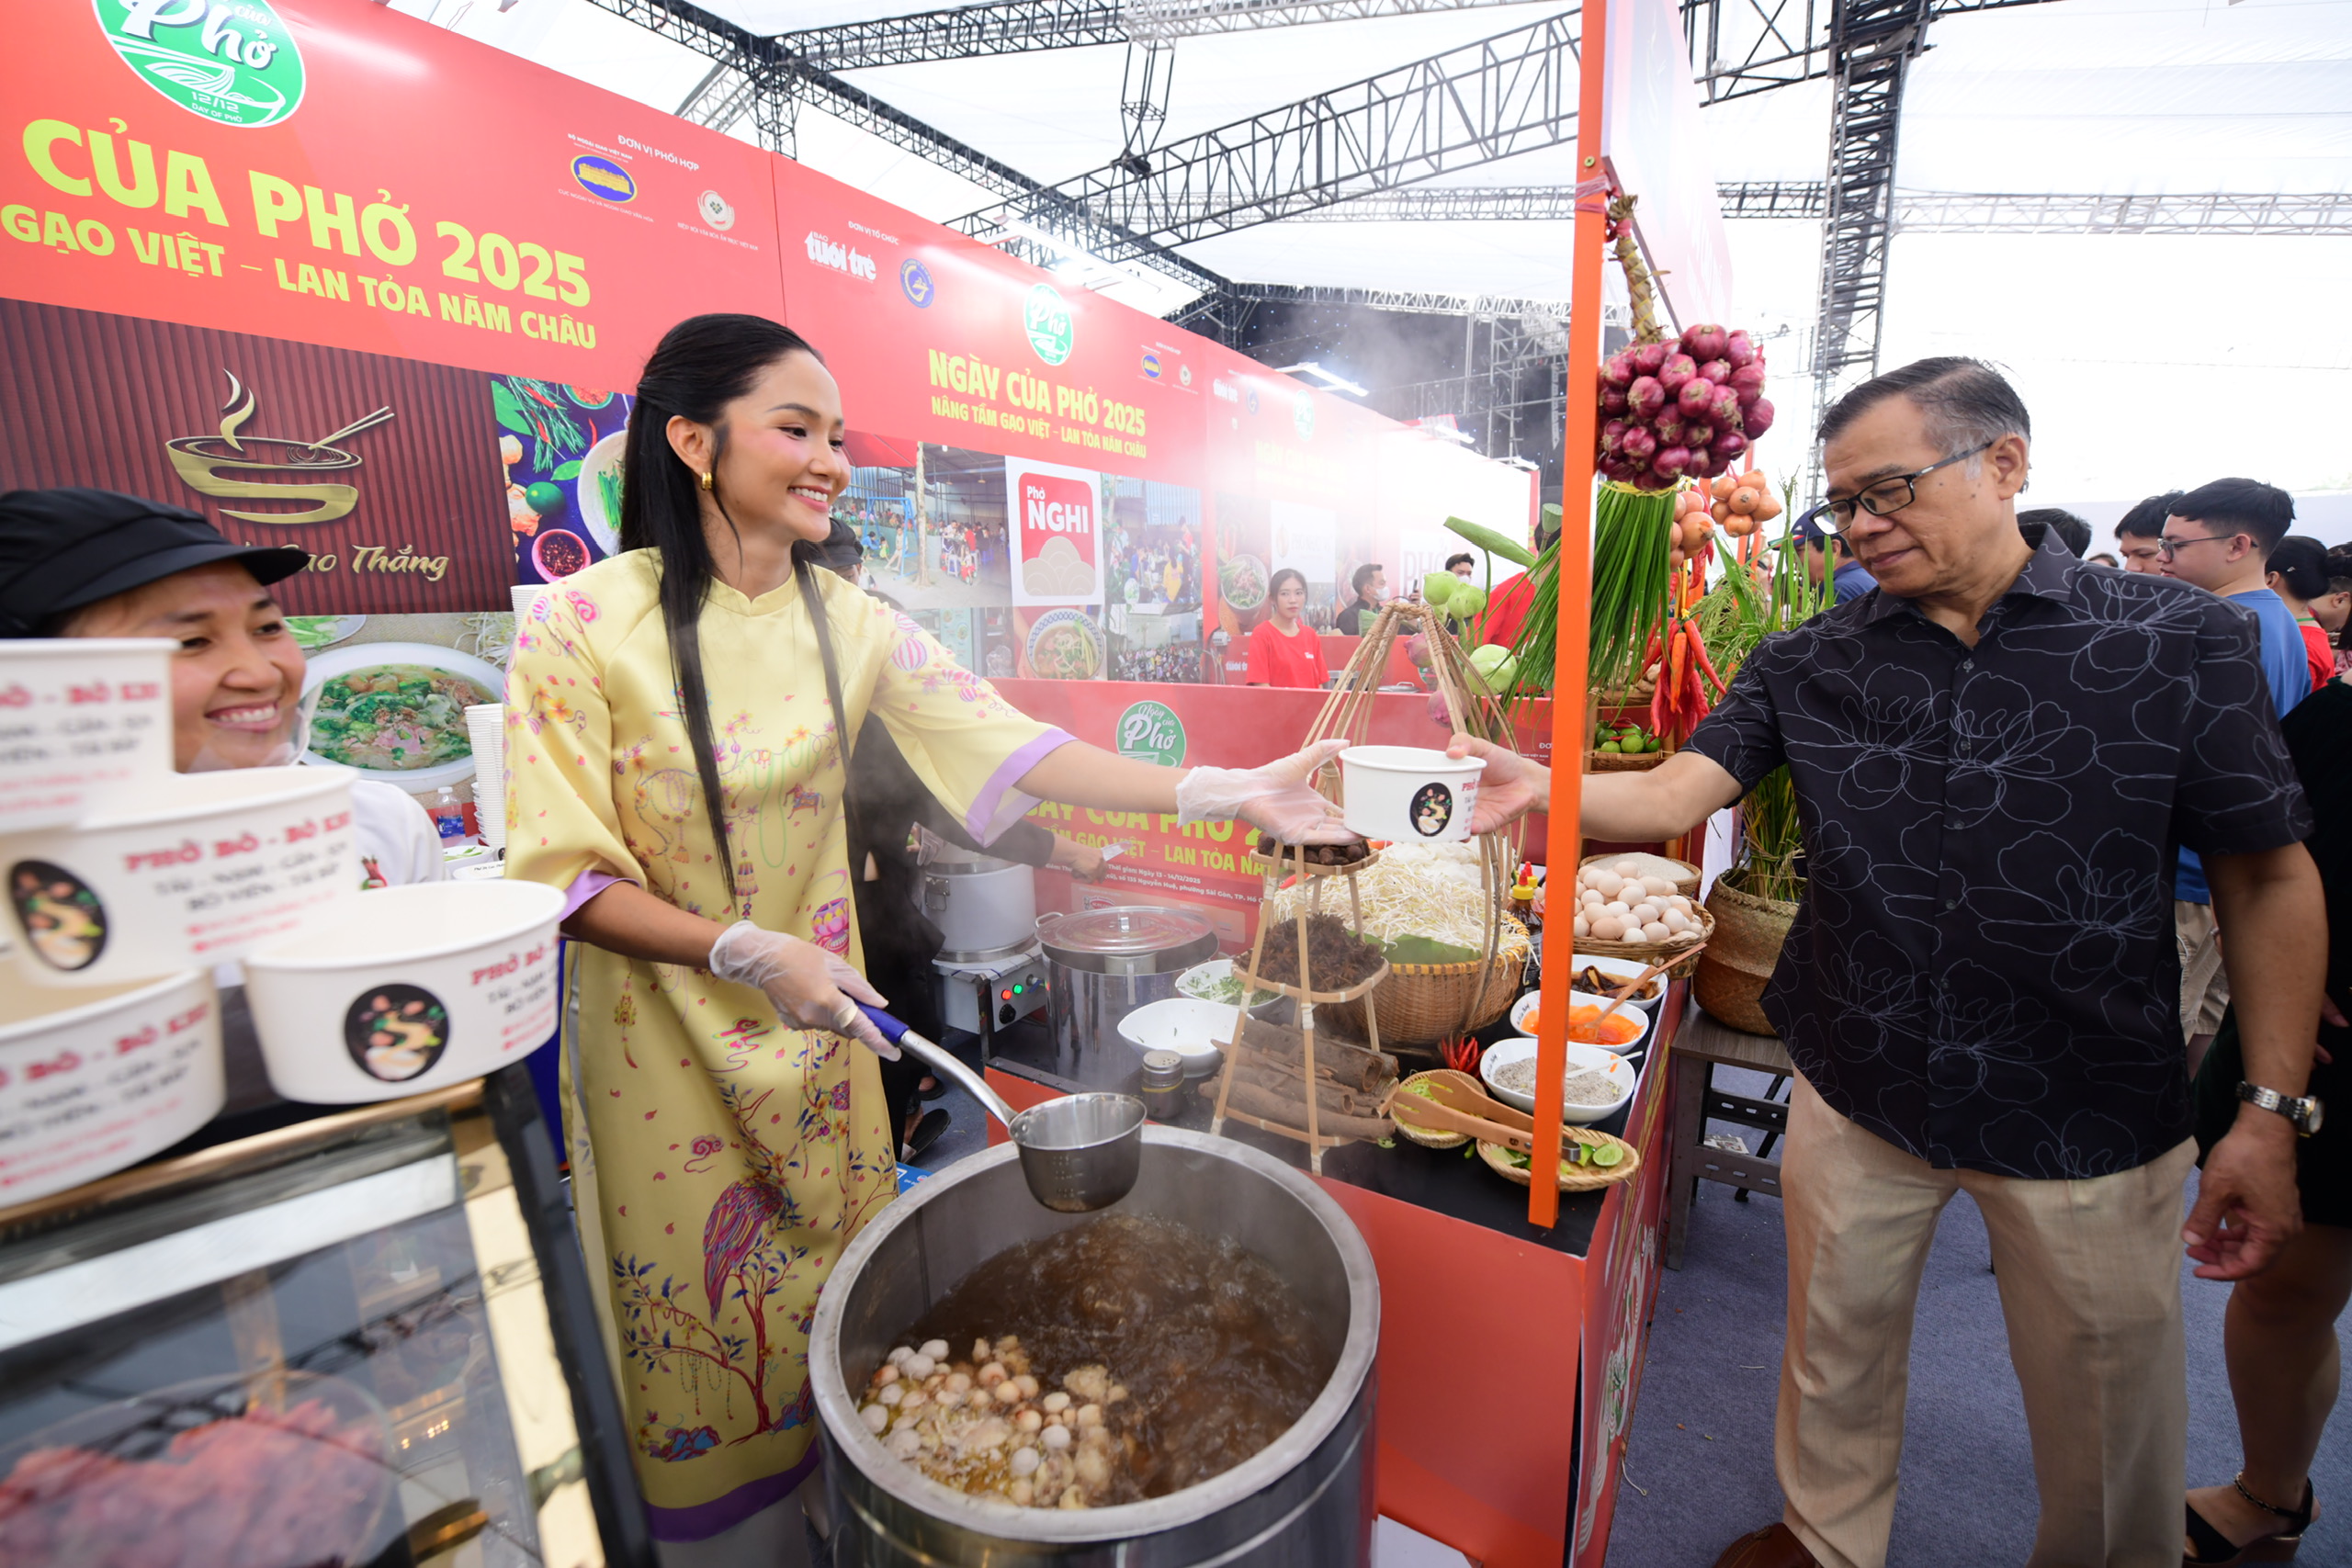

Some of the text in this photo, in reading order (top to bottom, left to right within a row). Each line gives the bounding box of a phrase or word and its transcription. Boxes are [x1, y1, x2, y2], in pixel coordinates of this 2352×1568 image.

[191, 91, 239, 113] 12/12
[191, 103, 209, 114] DAY
[211, 108, 222, 118] OF
[617, 134, 641, 151] ĐƠN
[642, 144, 653, 157] VỊ
[654, 149, 678, 165] PHỐI
[679, 156, 699, 172] HỢP
[22, 117, 591, 308] CỦA PHỞ 2025
[848, 220, 864, 232] ĐƠN
[0, 204, 115, 256] GẠO
[126, 231, 225, 277] VIỆT
[274, 258, 350, 302] LAN
[357, 274, 431, 317] TỎA
[439, 290, 512, 334] NĂM
[519, 310, 596, 350] CHÂU
[929, 348, 1146, 437] NGÀY CỦA PHỞ 2025
[931, 395, 969, 422] NÂNG
[971, 402, 997, 427] TẦM
[1001, 412, 1025, 433] GẠO
[1027, 418, 1050, 440] VIỆT
[1061, 426, 1080, 446] LAN
[1081, 429, 1101, 449] TỎA
[1102, 434, 1123, 454] NĂM
[1125, 439, 1147, 459] CHÂU
[1026, 485, 1046, 501] Phở
[1027, 500, 1089, 534] NGHI
[352, 544, 449, 582] Thắng
[1138, 705, 1165, 720] Ngày
[1124, 714, 1177, 750] Phở
[1164, 844, 1196, 865] LAN
[1200, 847, 1236, 873] TỎA
[1127, 875, 1136, 884] 135
[1138, 877, 1162, 890] Nguyễn
[1179, 883, 1204, 897] phường
[1205, 887, 1216, 897] Sài
[1234, 893, 1246, 901] TP.
[1138, 867, 1155, 878] Ngày
[1167, 871, 1201, 884] 14/12/2025
